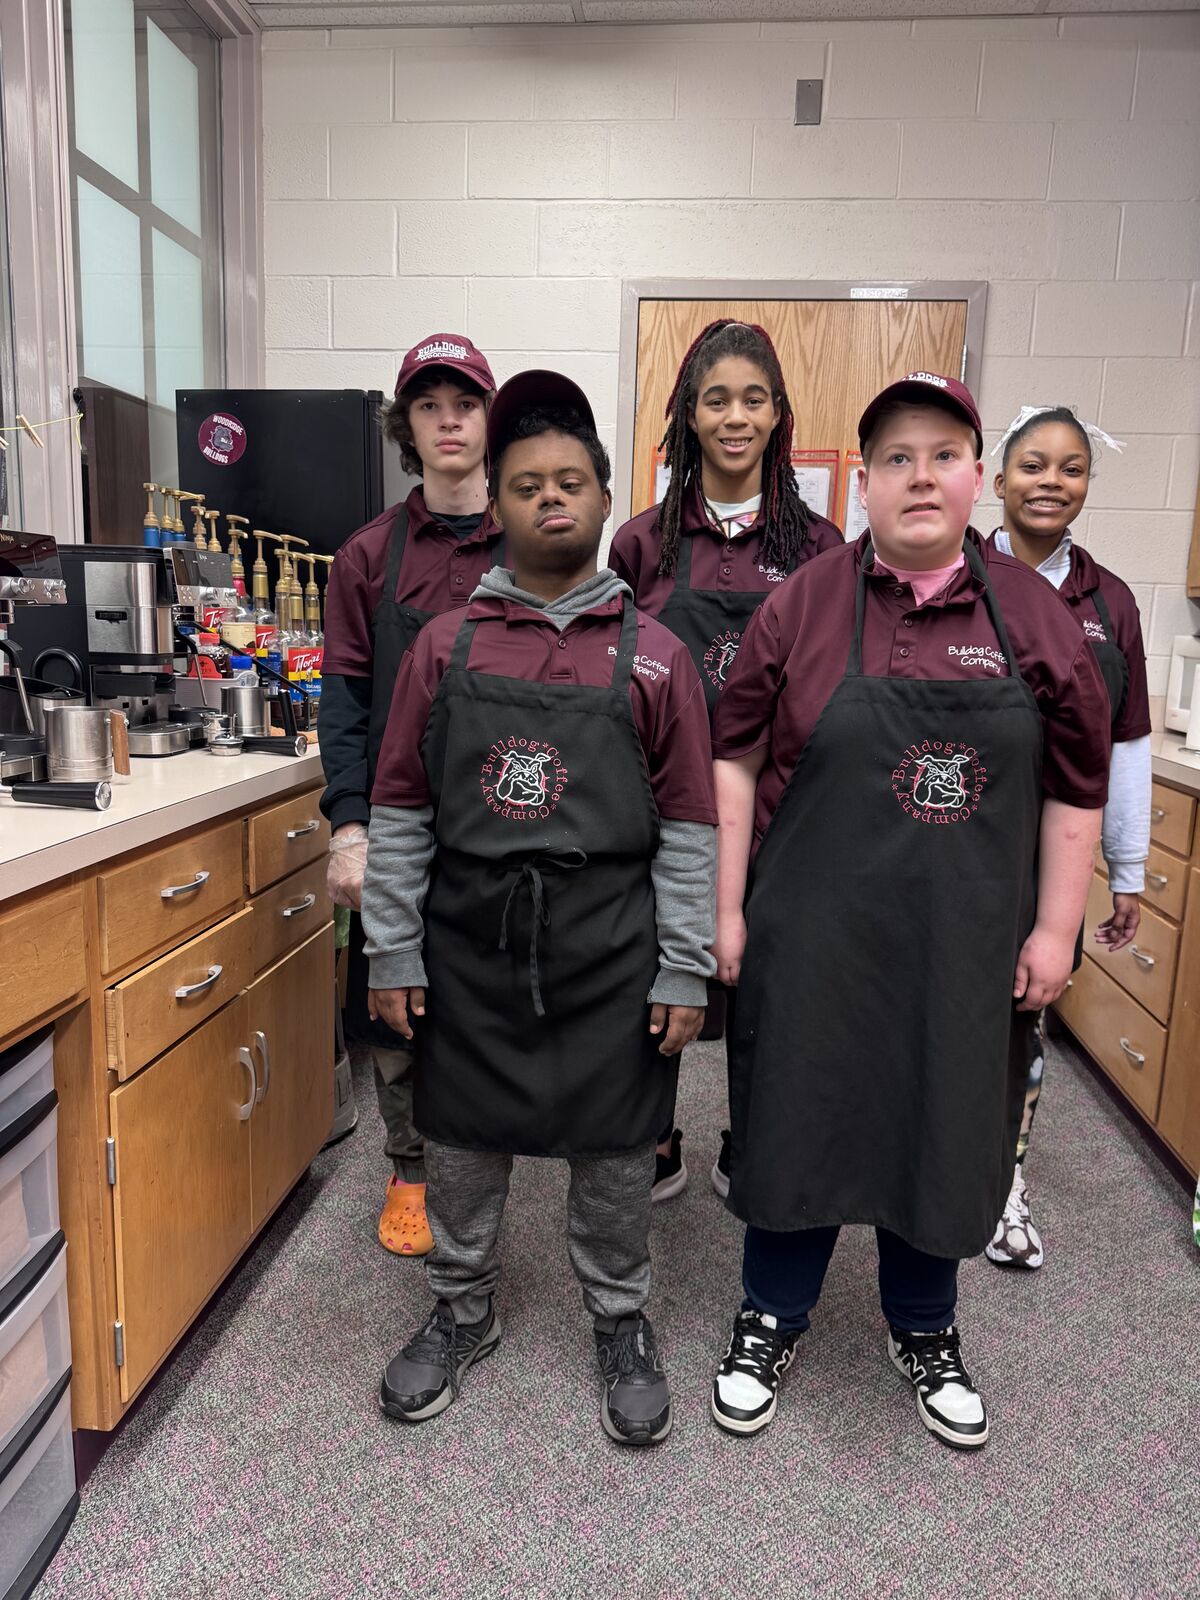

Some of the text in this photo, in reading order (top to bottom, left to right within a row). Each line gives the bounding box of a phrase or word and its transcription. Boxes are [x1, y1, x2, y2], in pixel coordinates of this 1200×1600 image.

[418, 341, 468, 359] BULLDOGS
[212, 414, 244, 436] WOODRIDGE
[203, 446, 229, 464] BULLDOGS
[702, 631, 744, 663] Bulldo
[948, 645, 984, 656] Bulldog
[640, 655, 670, 675] Coffee
[960, 655, 1001, 674] Company
[481, 735, 568, 820] Bulldog Coffee Company
[891, 739, 987, 824] Bulldog Coffee Company
